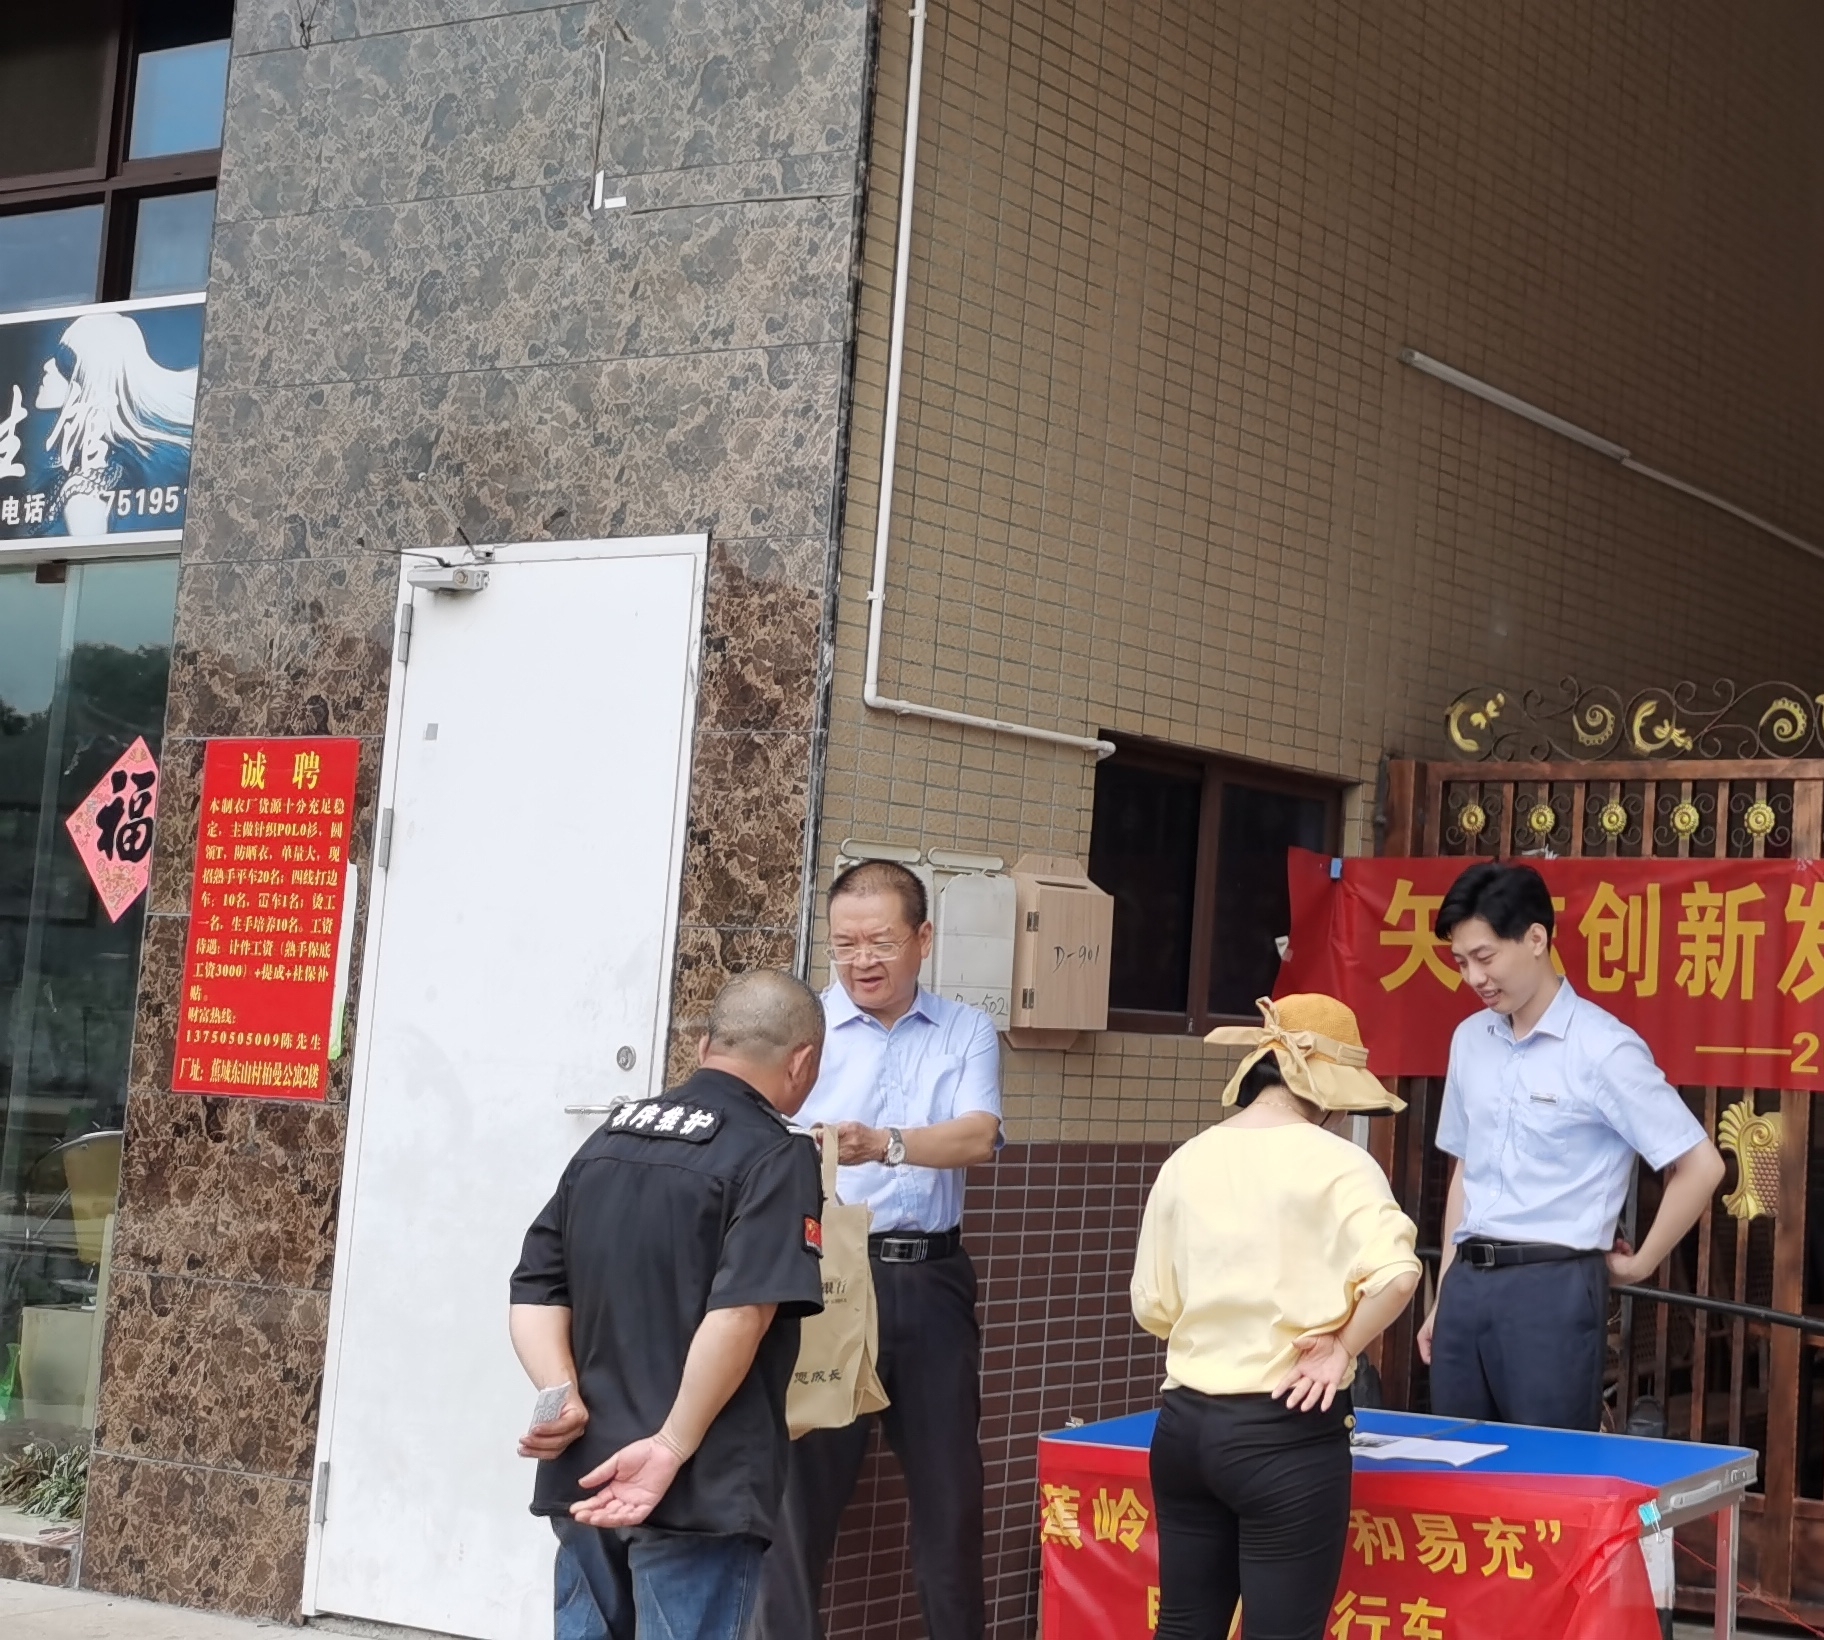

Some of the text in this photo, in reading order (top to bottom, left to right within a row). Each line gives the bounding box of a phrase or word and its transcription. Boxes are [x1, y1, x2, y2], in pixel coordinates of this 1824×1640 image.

[95, 769, 155, 863] 福
[208, 796, 345, 815] 本制衣厂货源十分充足稳
